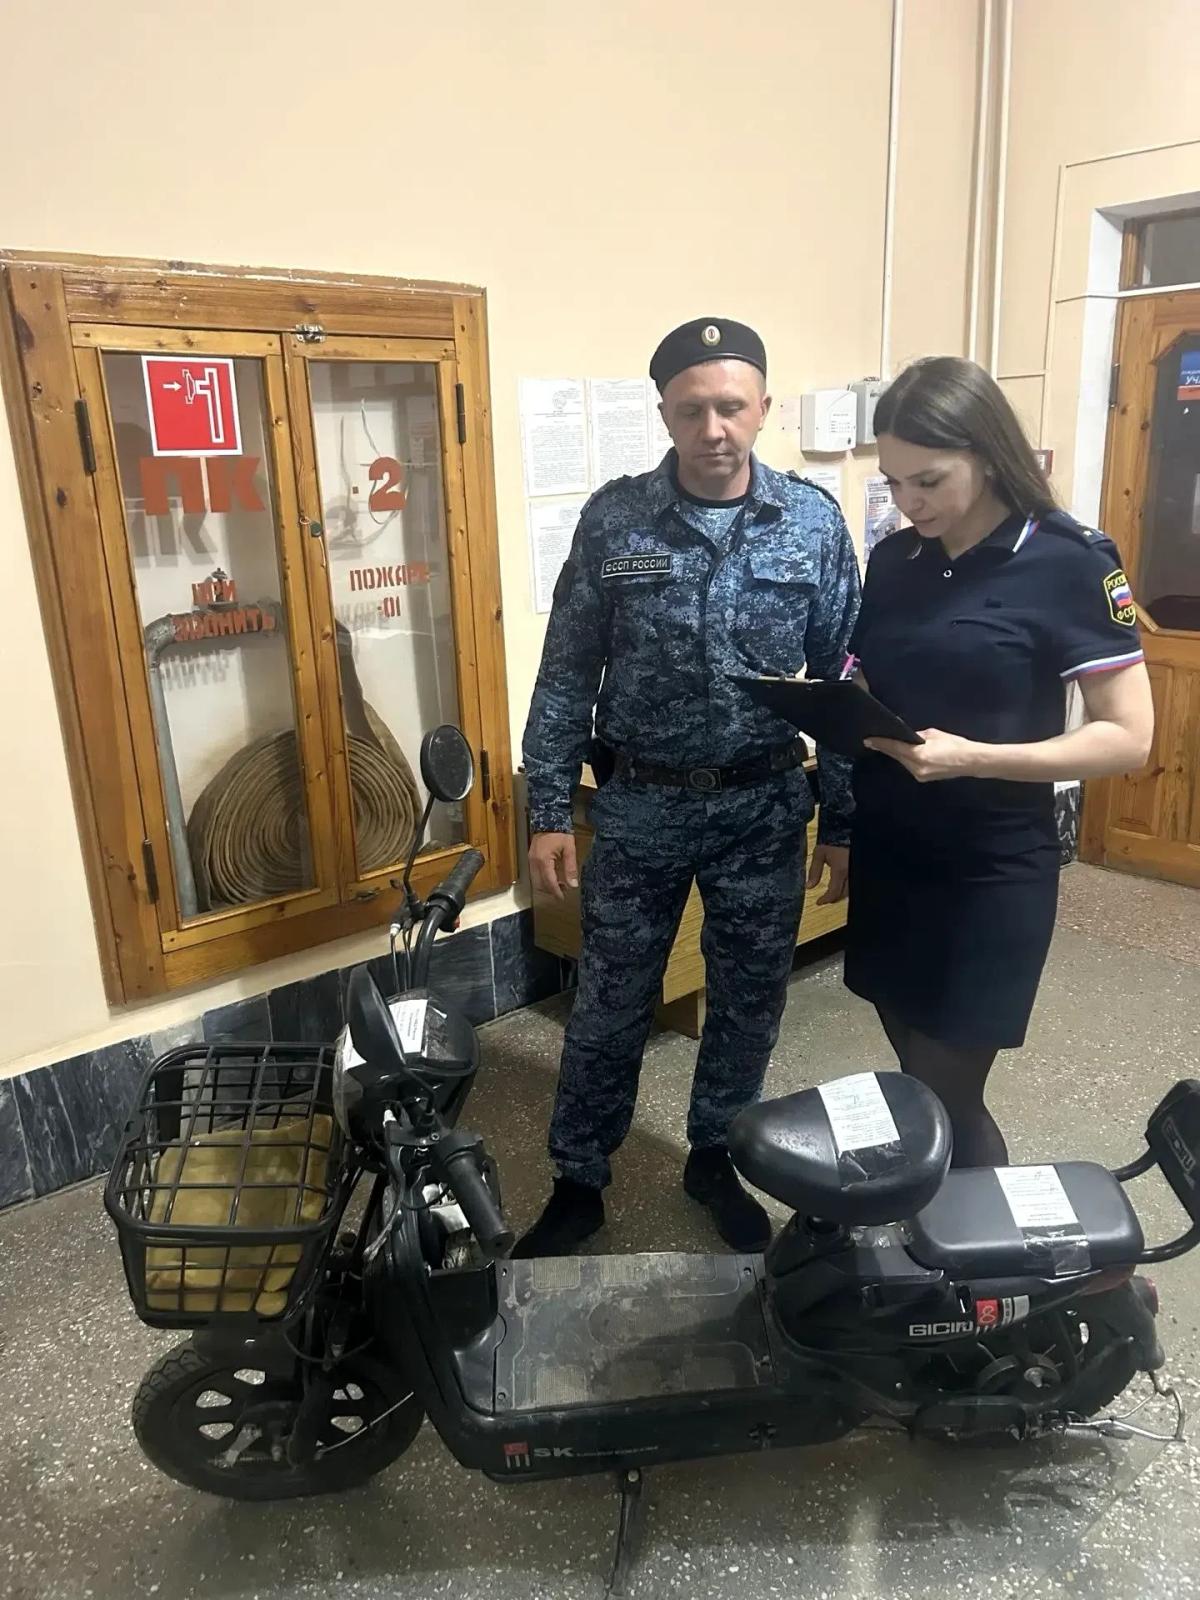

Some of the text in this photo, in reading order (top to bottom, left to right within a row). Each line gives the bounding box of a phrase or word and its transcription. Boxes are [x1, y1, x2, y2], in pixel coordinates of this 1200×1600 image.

[140, 456, 266, 516] ПК
[632, 558, 668, 570] РОССИИ
[533, 1447, 574, 1458] SK
